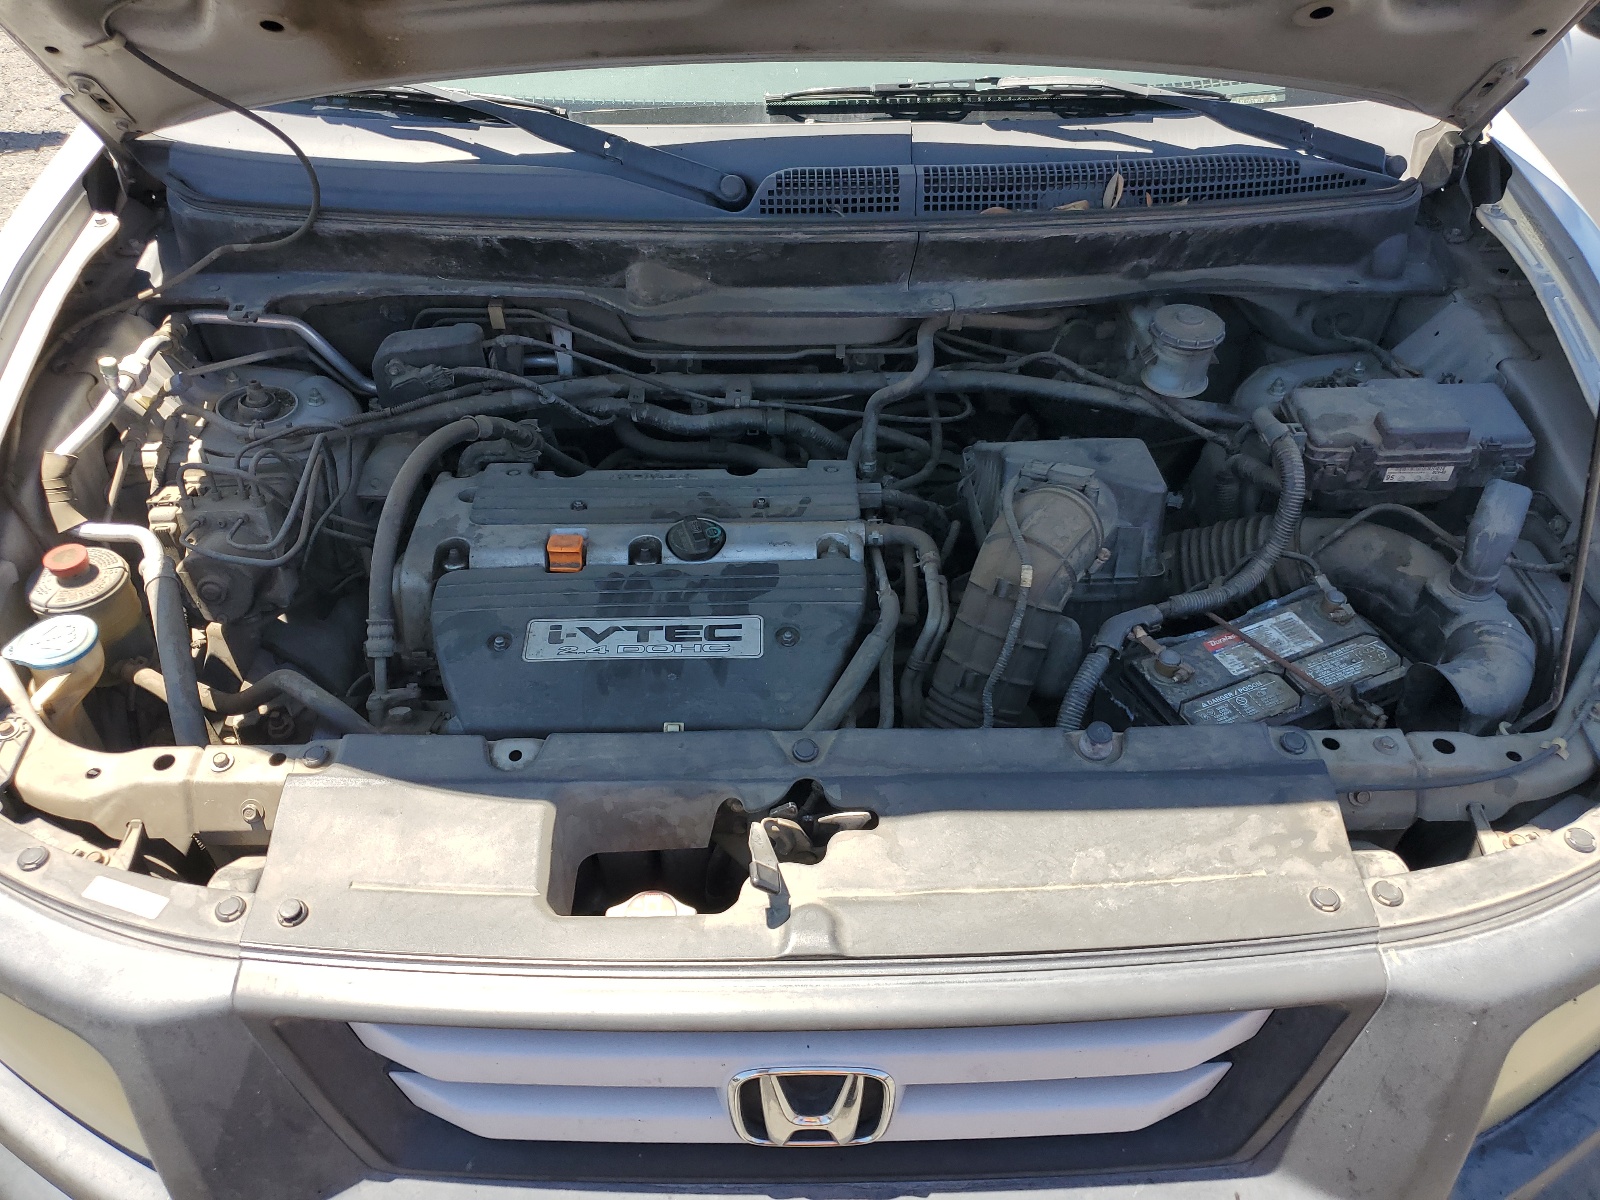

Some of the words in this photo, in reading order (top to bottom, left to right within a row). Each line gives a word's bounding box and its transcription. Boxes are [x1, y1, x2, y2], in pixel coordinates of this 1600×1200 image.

[548, 624, 743, 645] i-VTEC
[1207, 633, 1238, 647] Duralas
[556, 644, 610, 655] 2.4
[616, 643, 731, 654] DOHC
